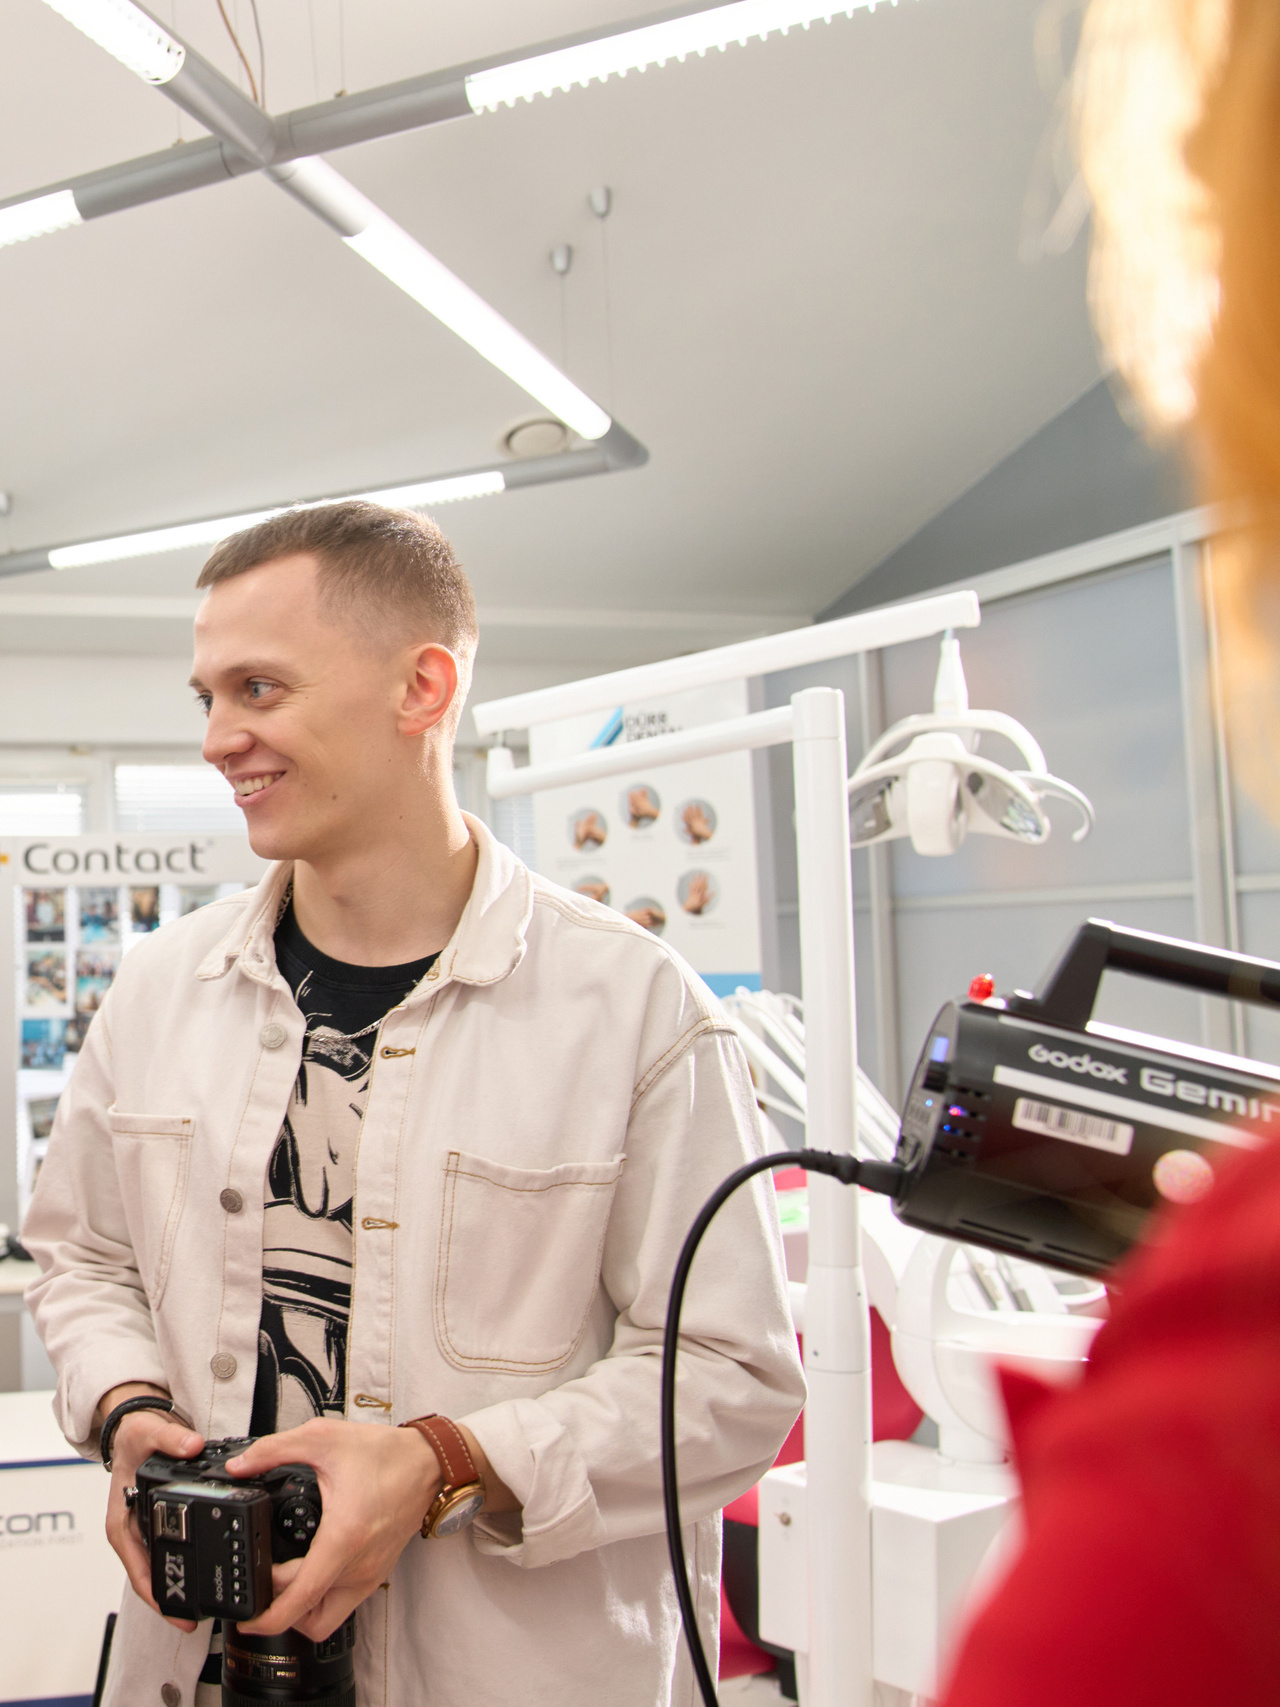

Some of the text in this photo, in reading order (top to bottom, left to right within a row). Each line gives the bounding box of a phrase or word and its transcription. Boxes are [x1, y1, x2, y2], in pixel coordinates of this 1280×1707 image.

[23, 841, 207, 875] Contact
[1027, 1043, 1129, 1085] Godox
[214, 1565, 224, 1602] Godox
